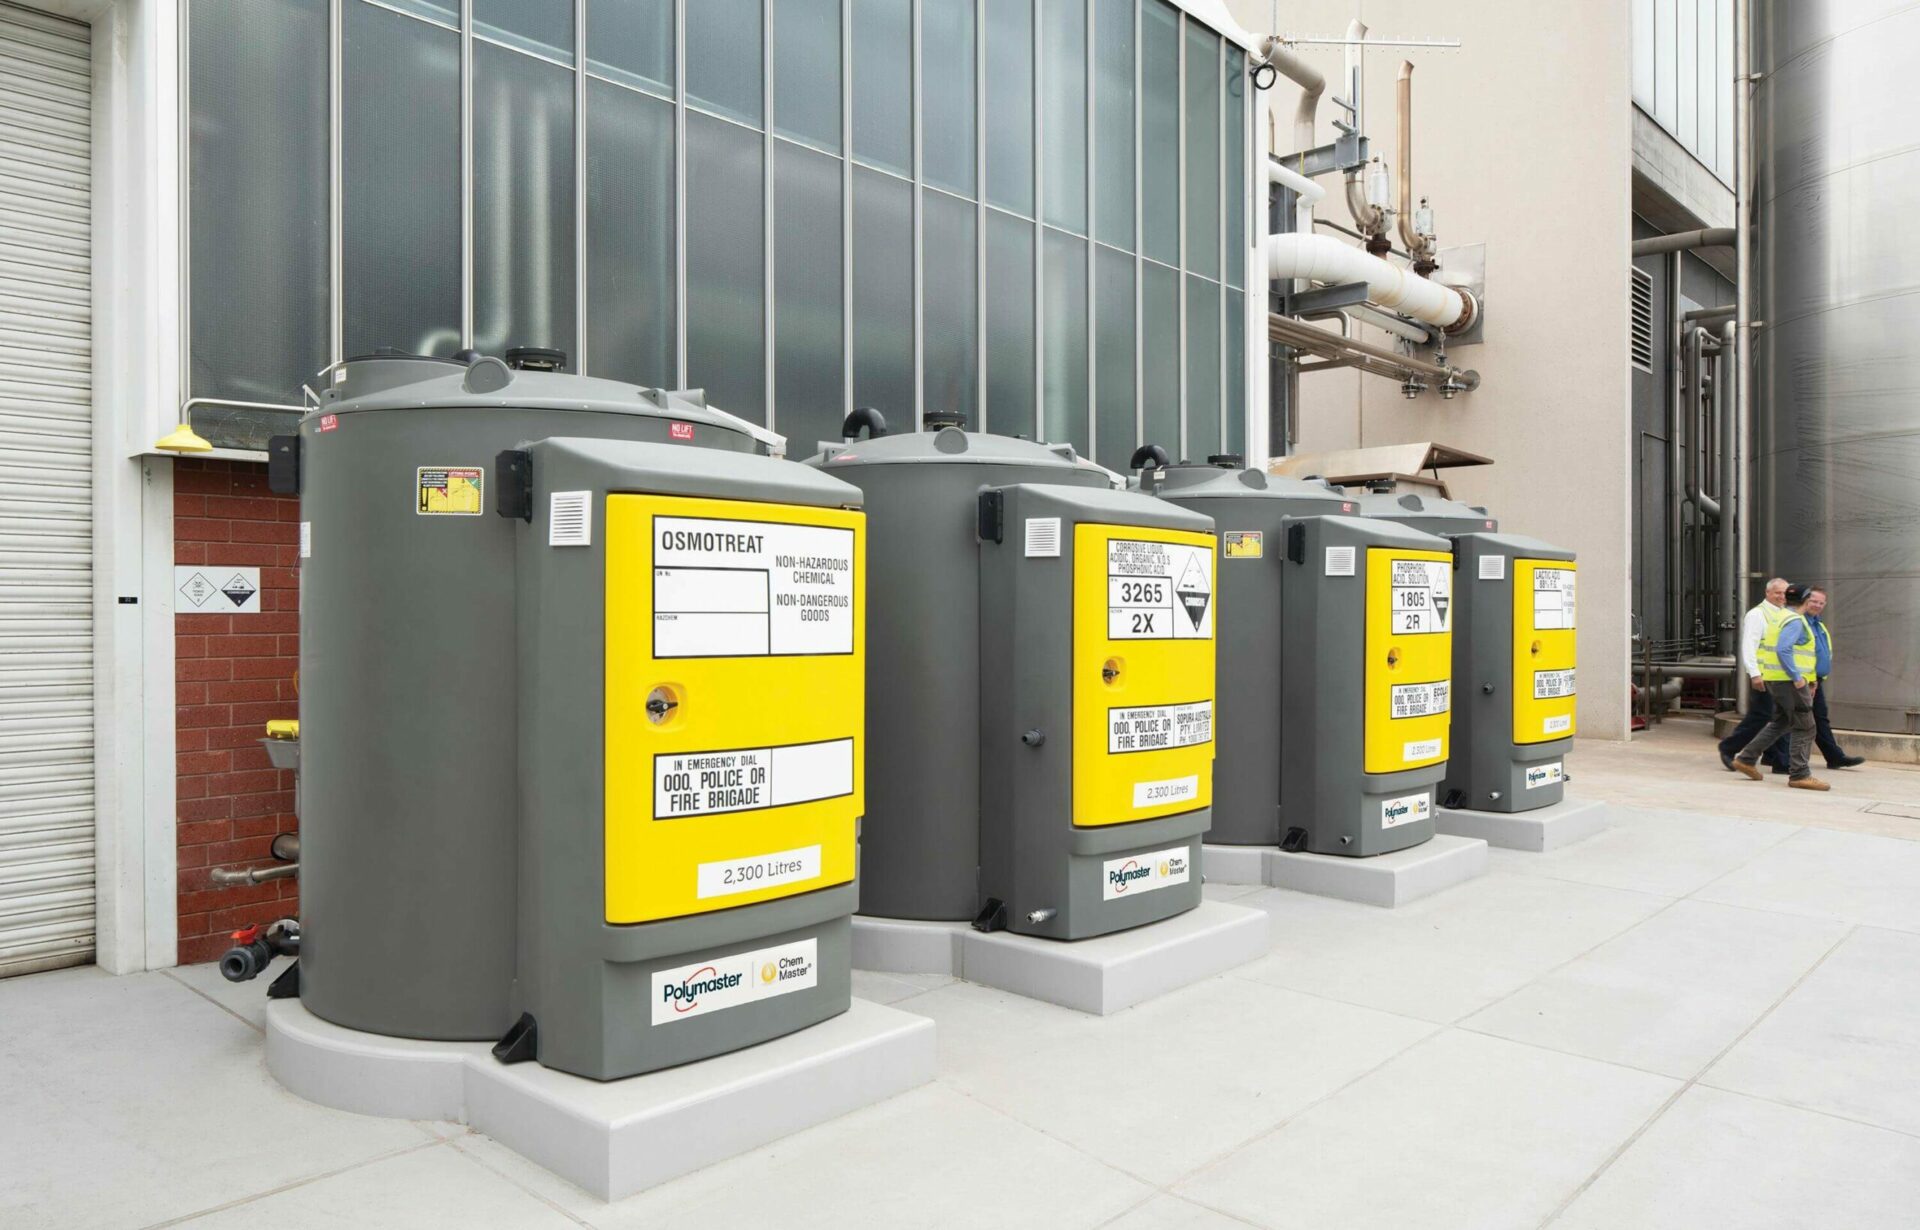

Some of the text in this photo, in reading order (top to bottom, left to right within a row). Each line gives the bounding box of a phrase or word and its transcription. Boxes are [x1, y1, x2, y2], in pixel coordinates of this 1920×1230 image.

[662, 530, 764, 553] OSMOTREAT
[1116, 542, 1146, 553] CORROSIVE
[775, 555, 848, 571] NON-HAZARDOUS
[1154, 565, 1164, 575] ACID
[793, 571, 835, 585] CHEMICAL
[776, 593, 849, 608] NON-DANGEROUS
[1121, 582, 1162, 603] 3265
[1400, 592, 1424, 607] 1805
[800, 610, 830, 622] GOODS
[1132, 613, 1154, 634] 2X
[1406, 614, 1420, 630] 2R
[1127, 710, 1154, 719] EMERGENCY
[1157, 710, 1166, 718] DIAL
[1135, 720, 1158, 733] POLICE
[1162, 718, 1171, 731] OR
[1118, 733, 1168, 749] FIRE BRIGADE
[674, 755, 758, 771] IN EMERGENCY DIAL
[701, 769, 743, 790] POLICE
[750, 767, 765, 785] OR
[671, 787, 760, 812] FIRE BRIGADE
[724, 859, 802, 885] 2,300 Litres
[1110, 866, 1150, 886] Polymaster
[779, 956, 804, 969] Chem
[664, 973, 742, 1003] Polymaster
